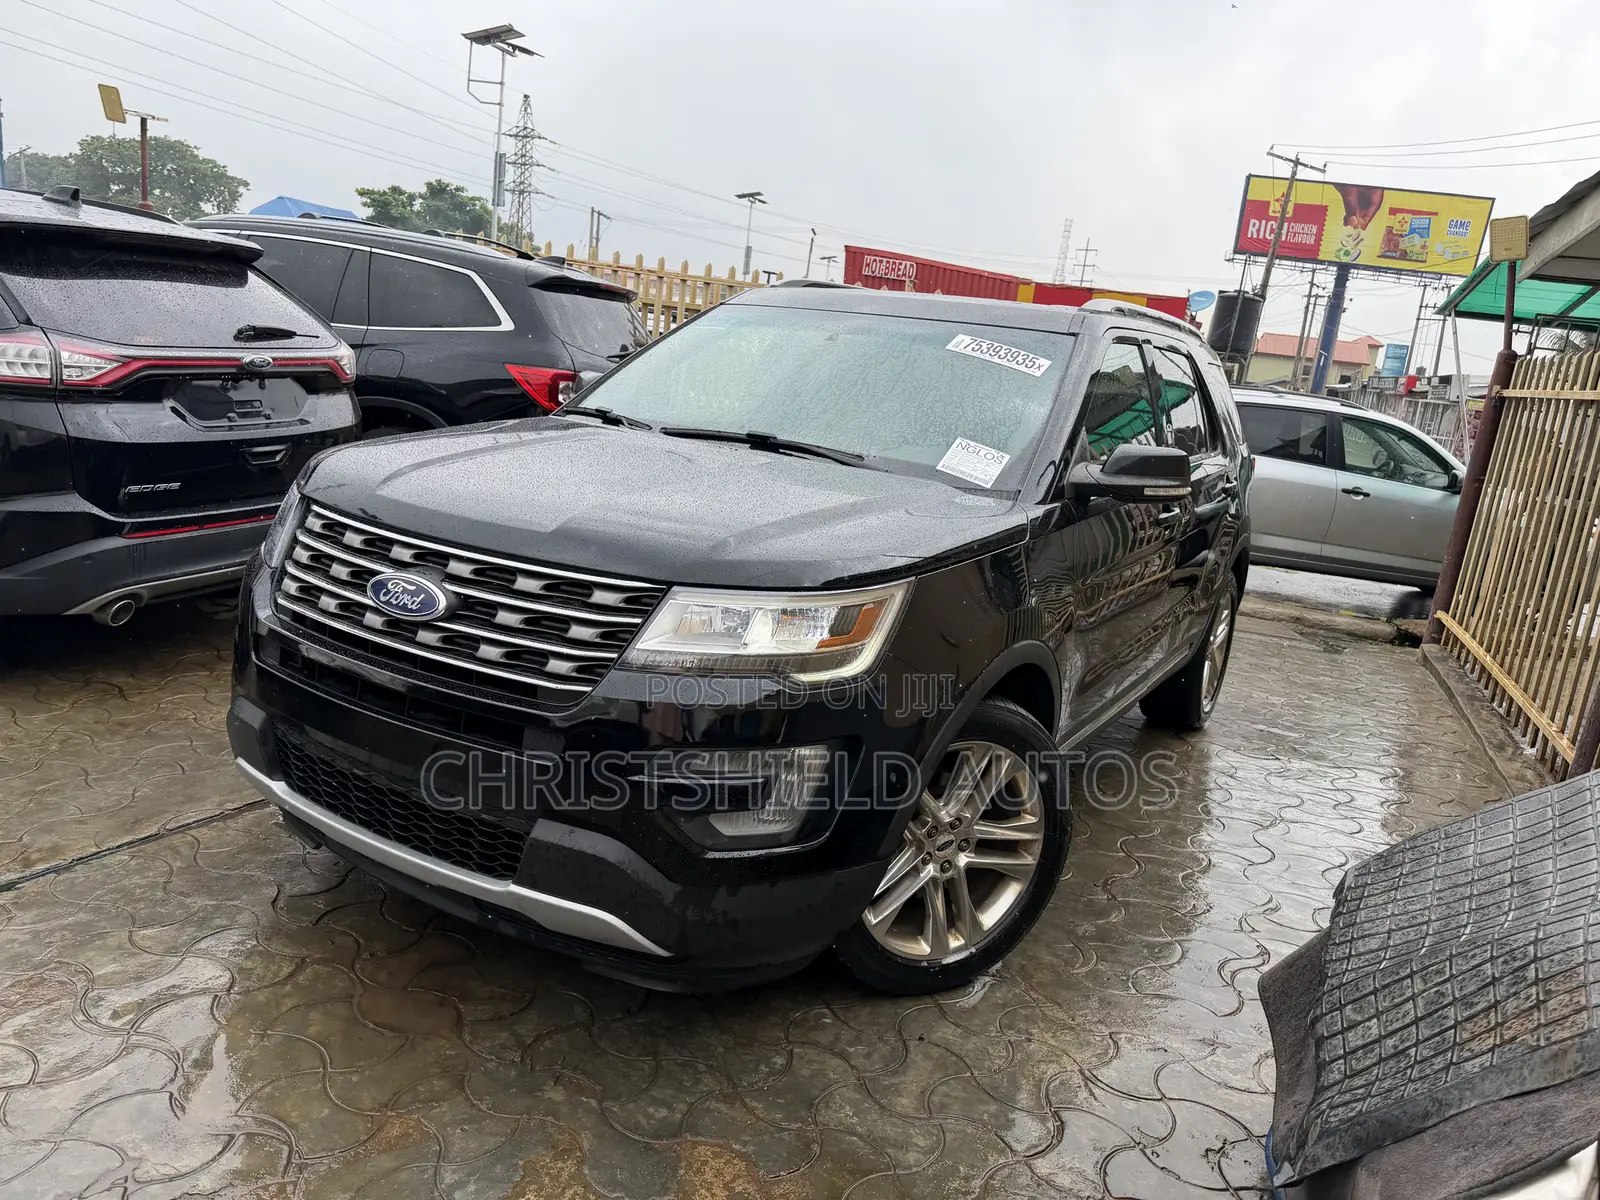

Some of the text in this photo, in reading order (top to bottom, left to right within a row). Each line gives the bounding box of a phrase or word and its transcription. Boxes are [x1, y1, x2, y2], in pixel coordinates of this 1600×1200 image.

[1289, 222, 1318, 235] CHICKEN
[1287, 232, 1316, 245] FLAVOUR
[955, 441, 1005, 465] NGLOS
[125, 482, 182, 493] EDGE
[379, 579, 426, 610] Ford
